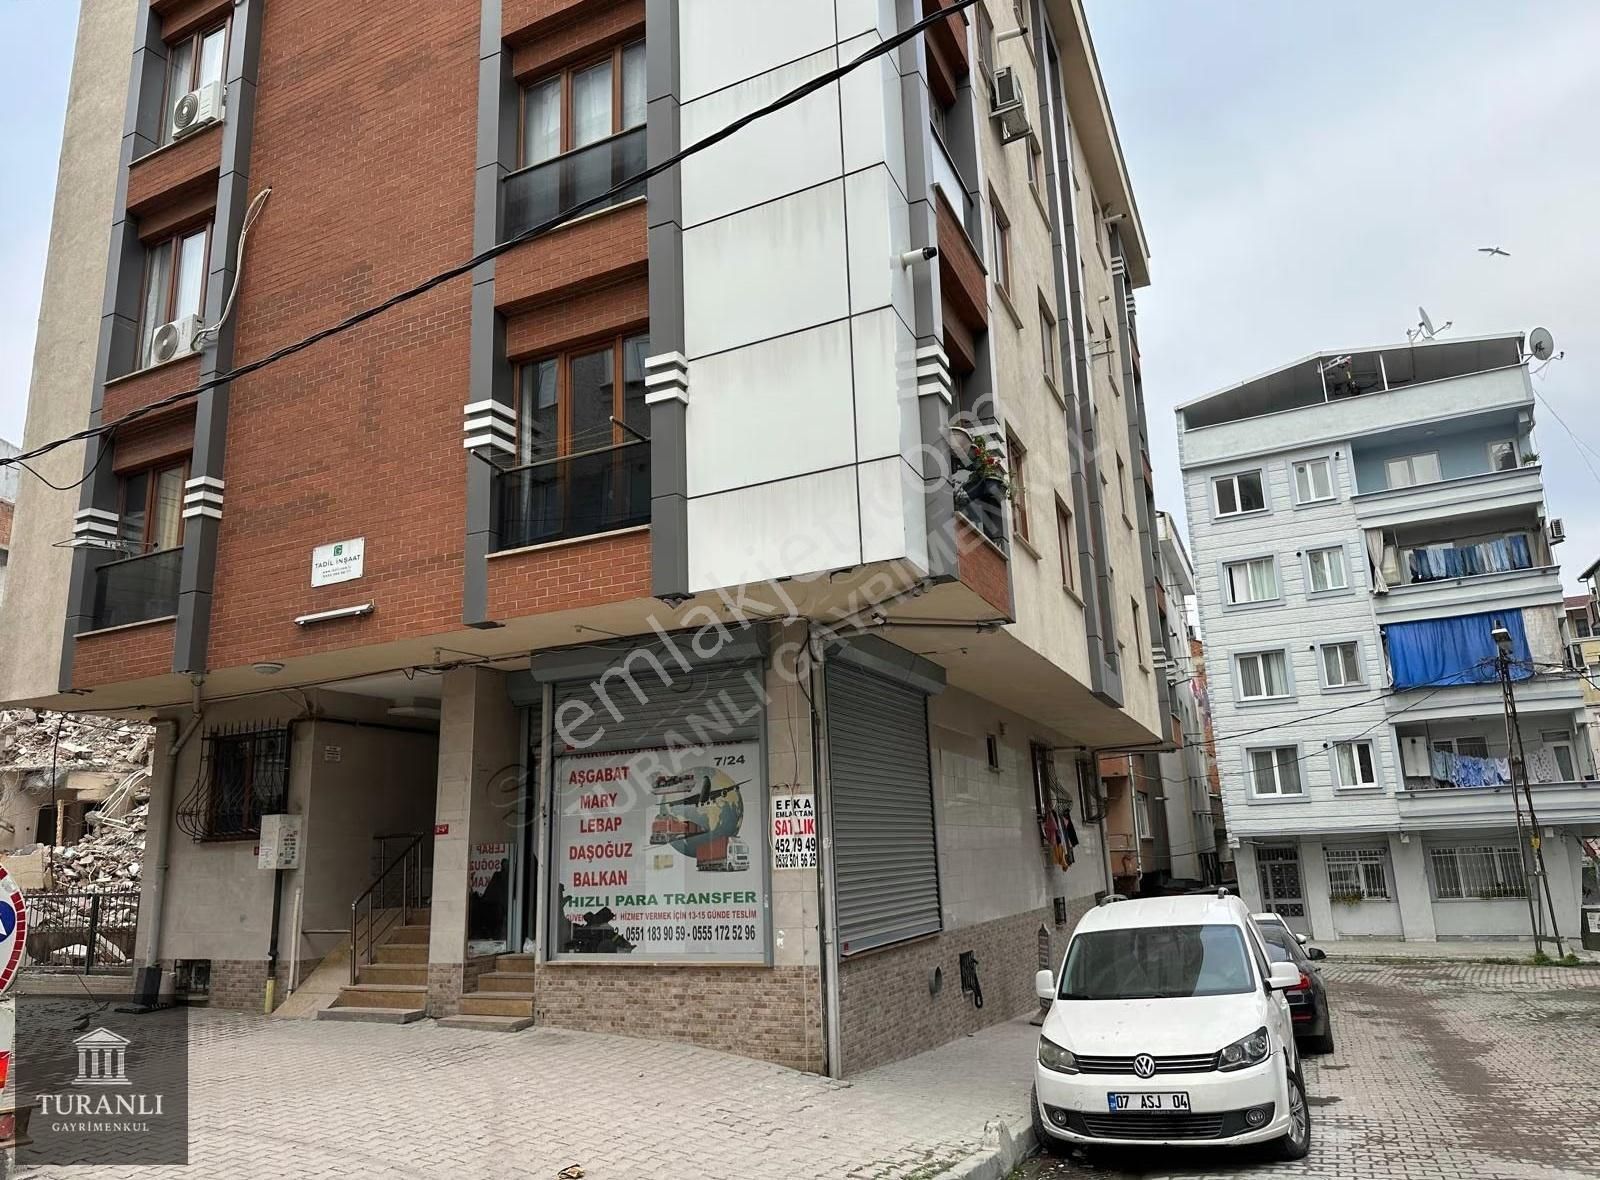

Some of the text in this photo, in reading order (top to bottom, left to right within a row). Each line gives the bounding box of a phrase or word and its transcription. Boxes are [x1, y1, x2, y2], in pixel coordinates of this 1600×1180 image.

[714, 755, 746, 767] 7/24
[569, 766, 629, 787] AŞGABAT
[580, 793, 617, 809] MARY
[580, 817, 622, 833] LEBAP
[569, 841, 633, 863] DAŞOĞUZ
[775, 838, 816, 853] 452 79 49
[574, 870, 628, 887] BALKAN
[569, 892, 757, 908] HIZLI PARA TRANSFER
[620, 911, 643, 921] HİZMET
[645, 911, 670, 921] VERMEK
[673, 910, 687, 922] İÇİN
[688, 911, 706, 920] 13-15
[707, 910, 730, 920] GÜNDE
[732, 908, 757, 919] TESLİM
[626, 926, 644, 941] 0551
[647, 926, 661, 941] 183
[663, 926, 673, 941] 90
[675, 926, 686, 941] 59
[692, 925, 713, 941] 0555
[715, 925, 730, 941] 172
[732, 925, 743, 941] 52
[745, 925, 756, 941] 96
[1115, 1095, 1130, 1109] 07
[1141, 1095, 1162, 1109] ASJ
[1172, 1094, 1188, 1109] 04
